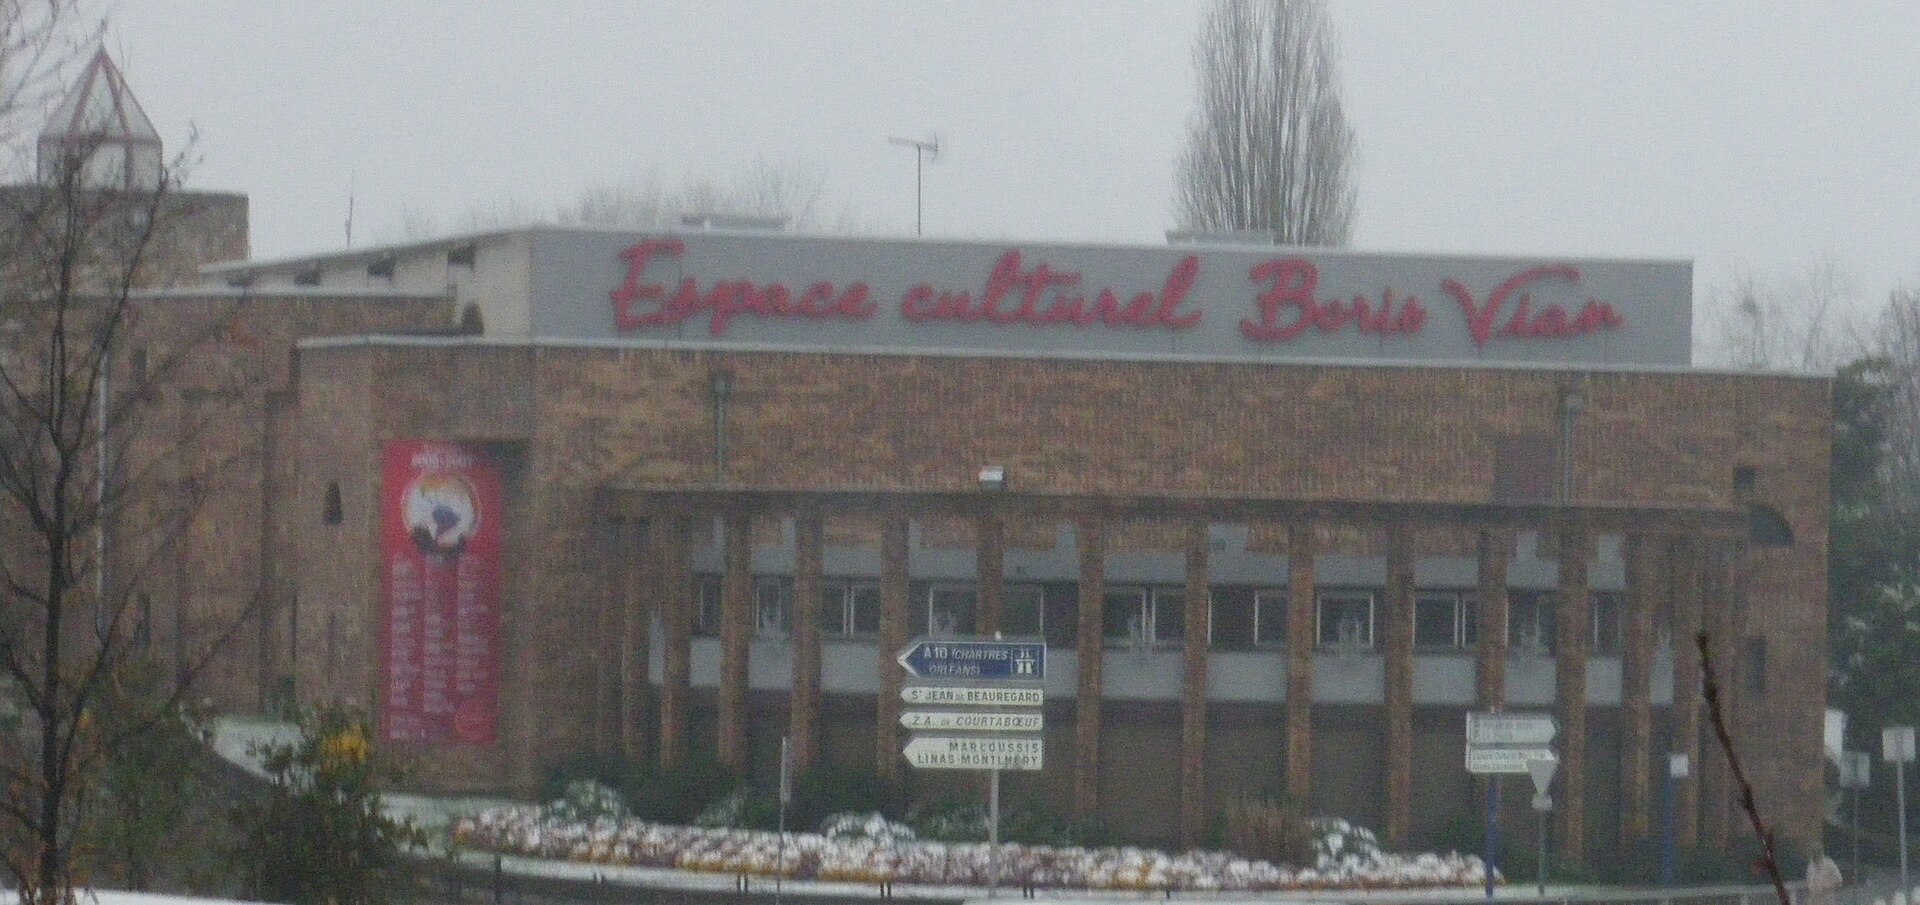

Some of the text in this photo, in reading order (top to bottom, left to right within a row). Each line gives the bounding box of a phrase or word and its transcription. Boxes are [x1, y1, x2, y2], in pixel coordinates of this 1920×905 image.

[610, 238, 1623, 345] Espace culturel Boris Vian
[925, 690, 954, 700] JEAN
[967, 691, 1040, 702] BEAUREGARD
[949, 742, 1039, 753] MARCOUSSIS
